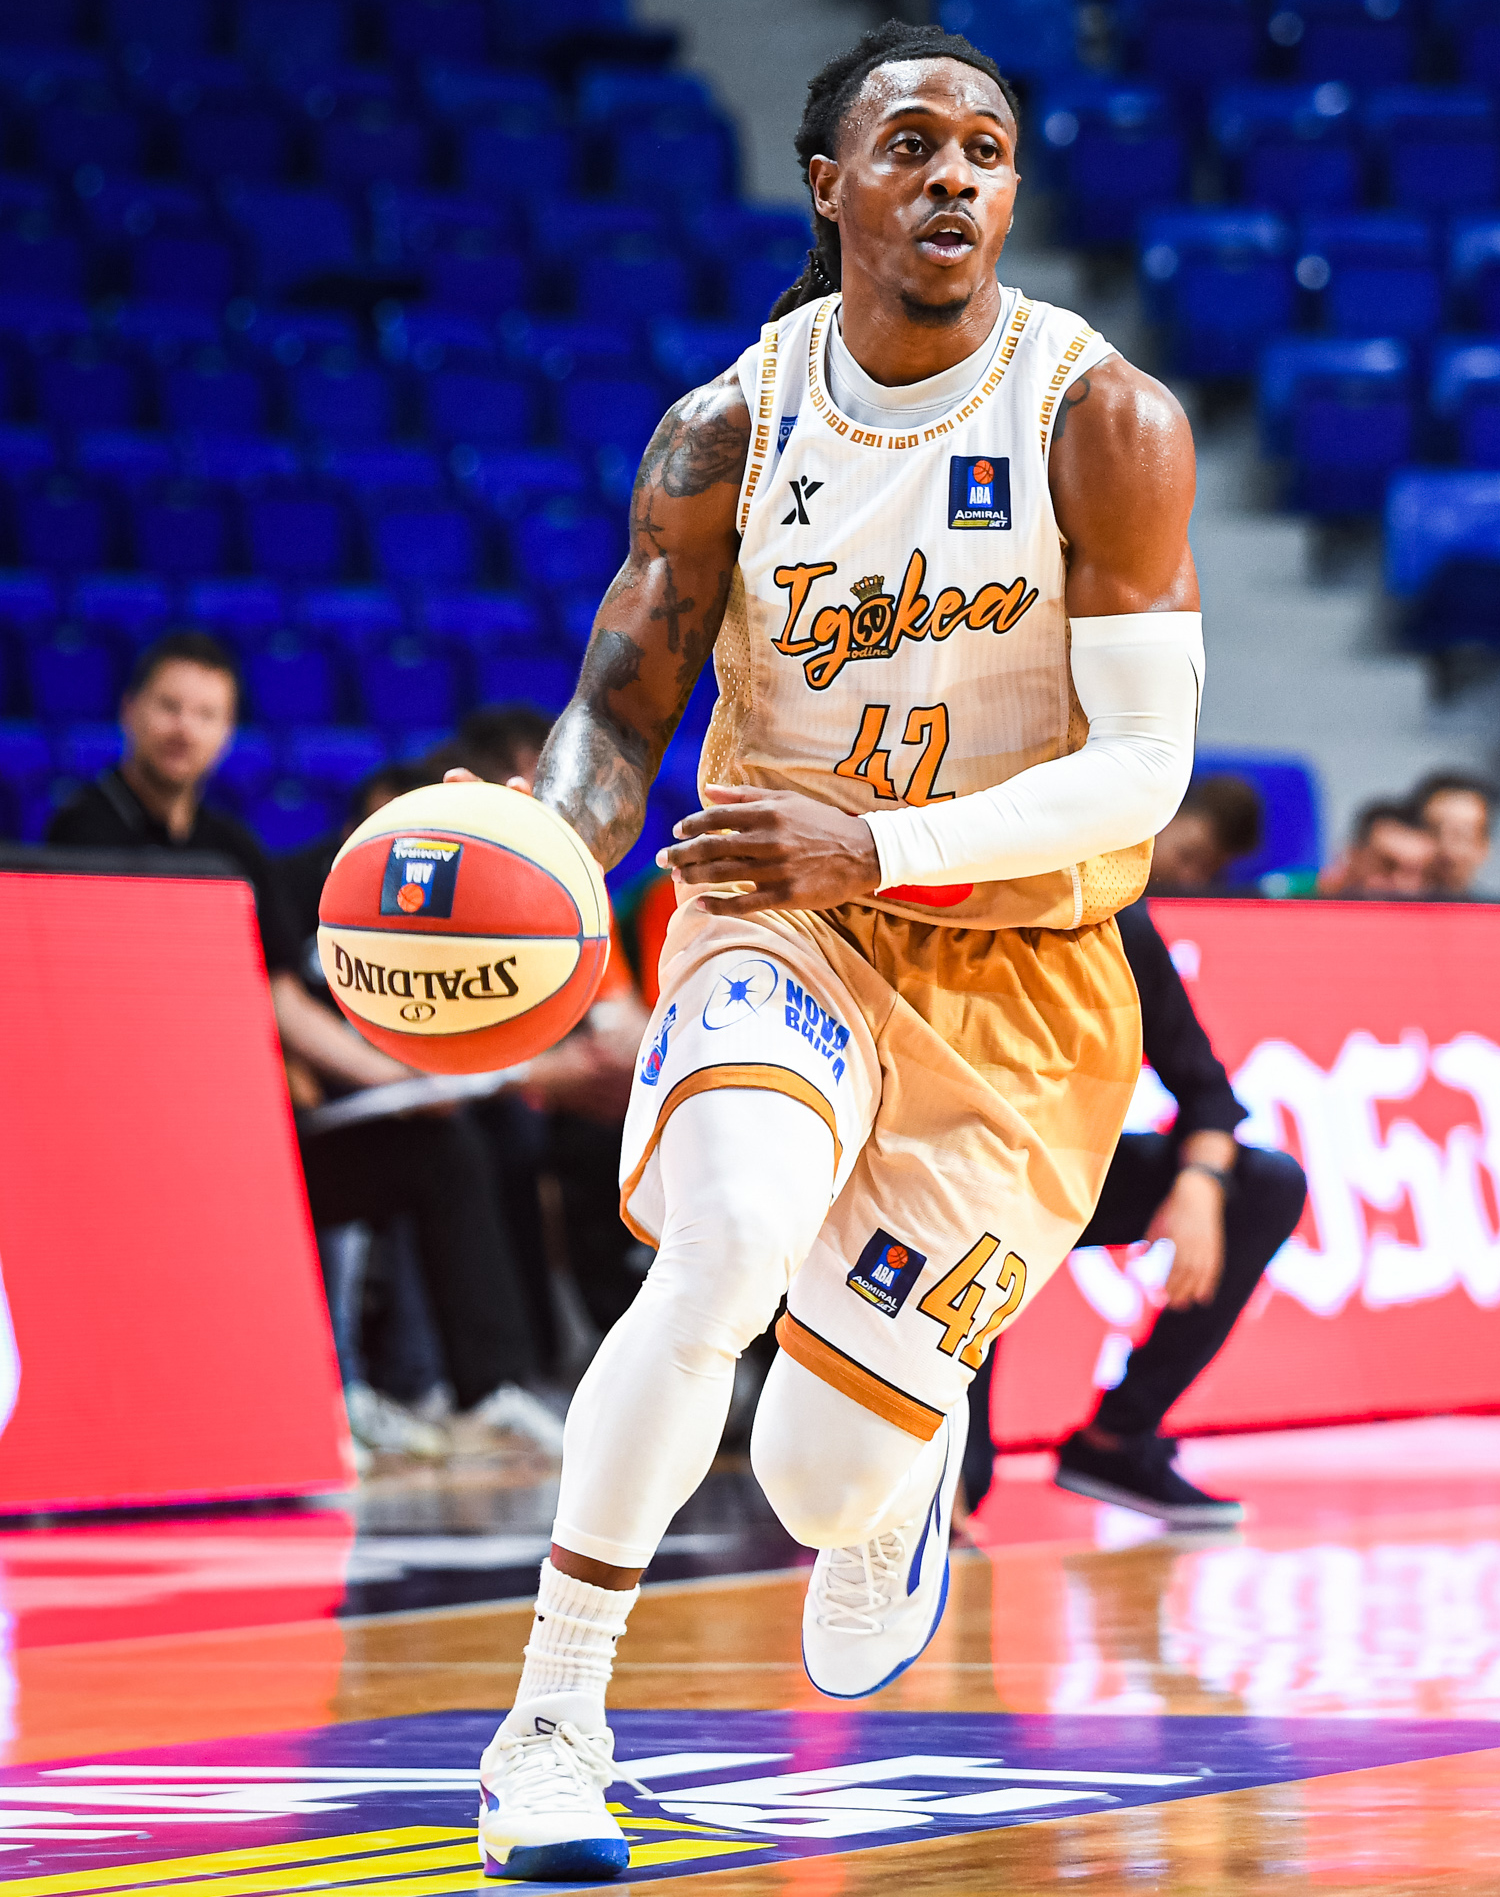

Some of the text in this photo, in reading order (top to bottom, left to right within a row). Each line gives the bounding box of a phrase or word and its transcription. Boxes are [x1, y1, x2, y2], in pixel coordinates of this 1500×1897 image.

[954, 510, 1008, 520] ADMIRAL
[969, 486, 991, 505] ABA
[771, 548, 1040, 690] Igokea
[833, 702, 956, 808] 42
[331, 941, 520, 1001] SPALDING
[851, 1275, 898, 1309] ADMIRAL
[871, 1263, 895, 1288] ABA
[916, 1232, 1027, 1372] 42
